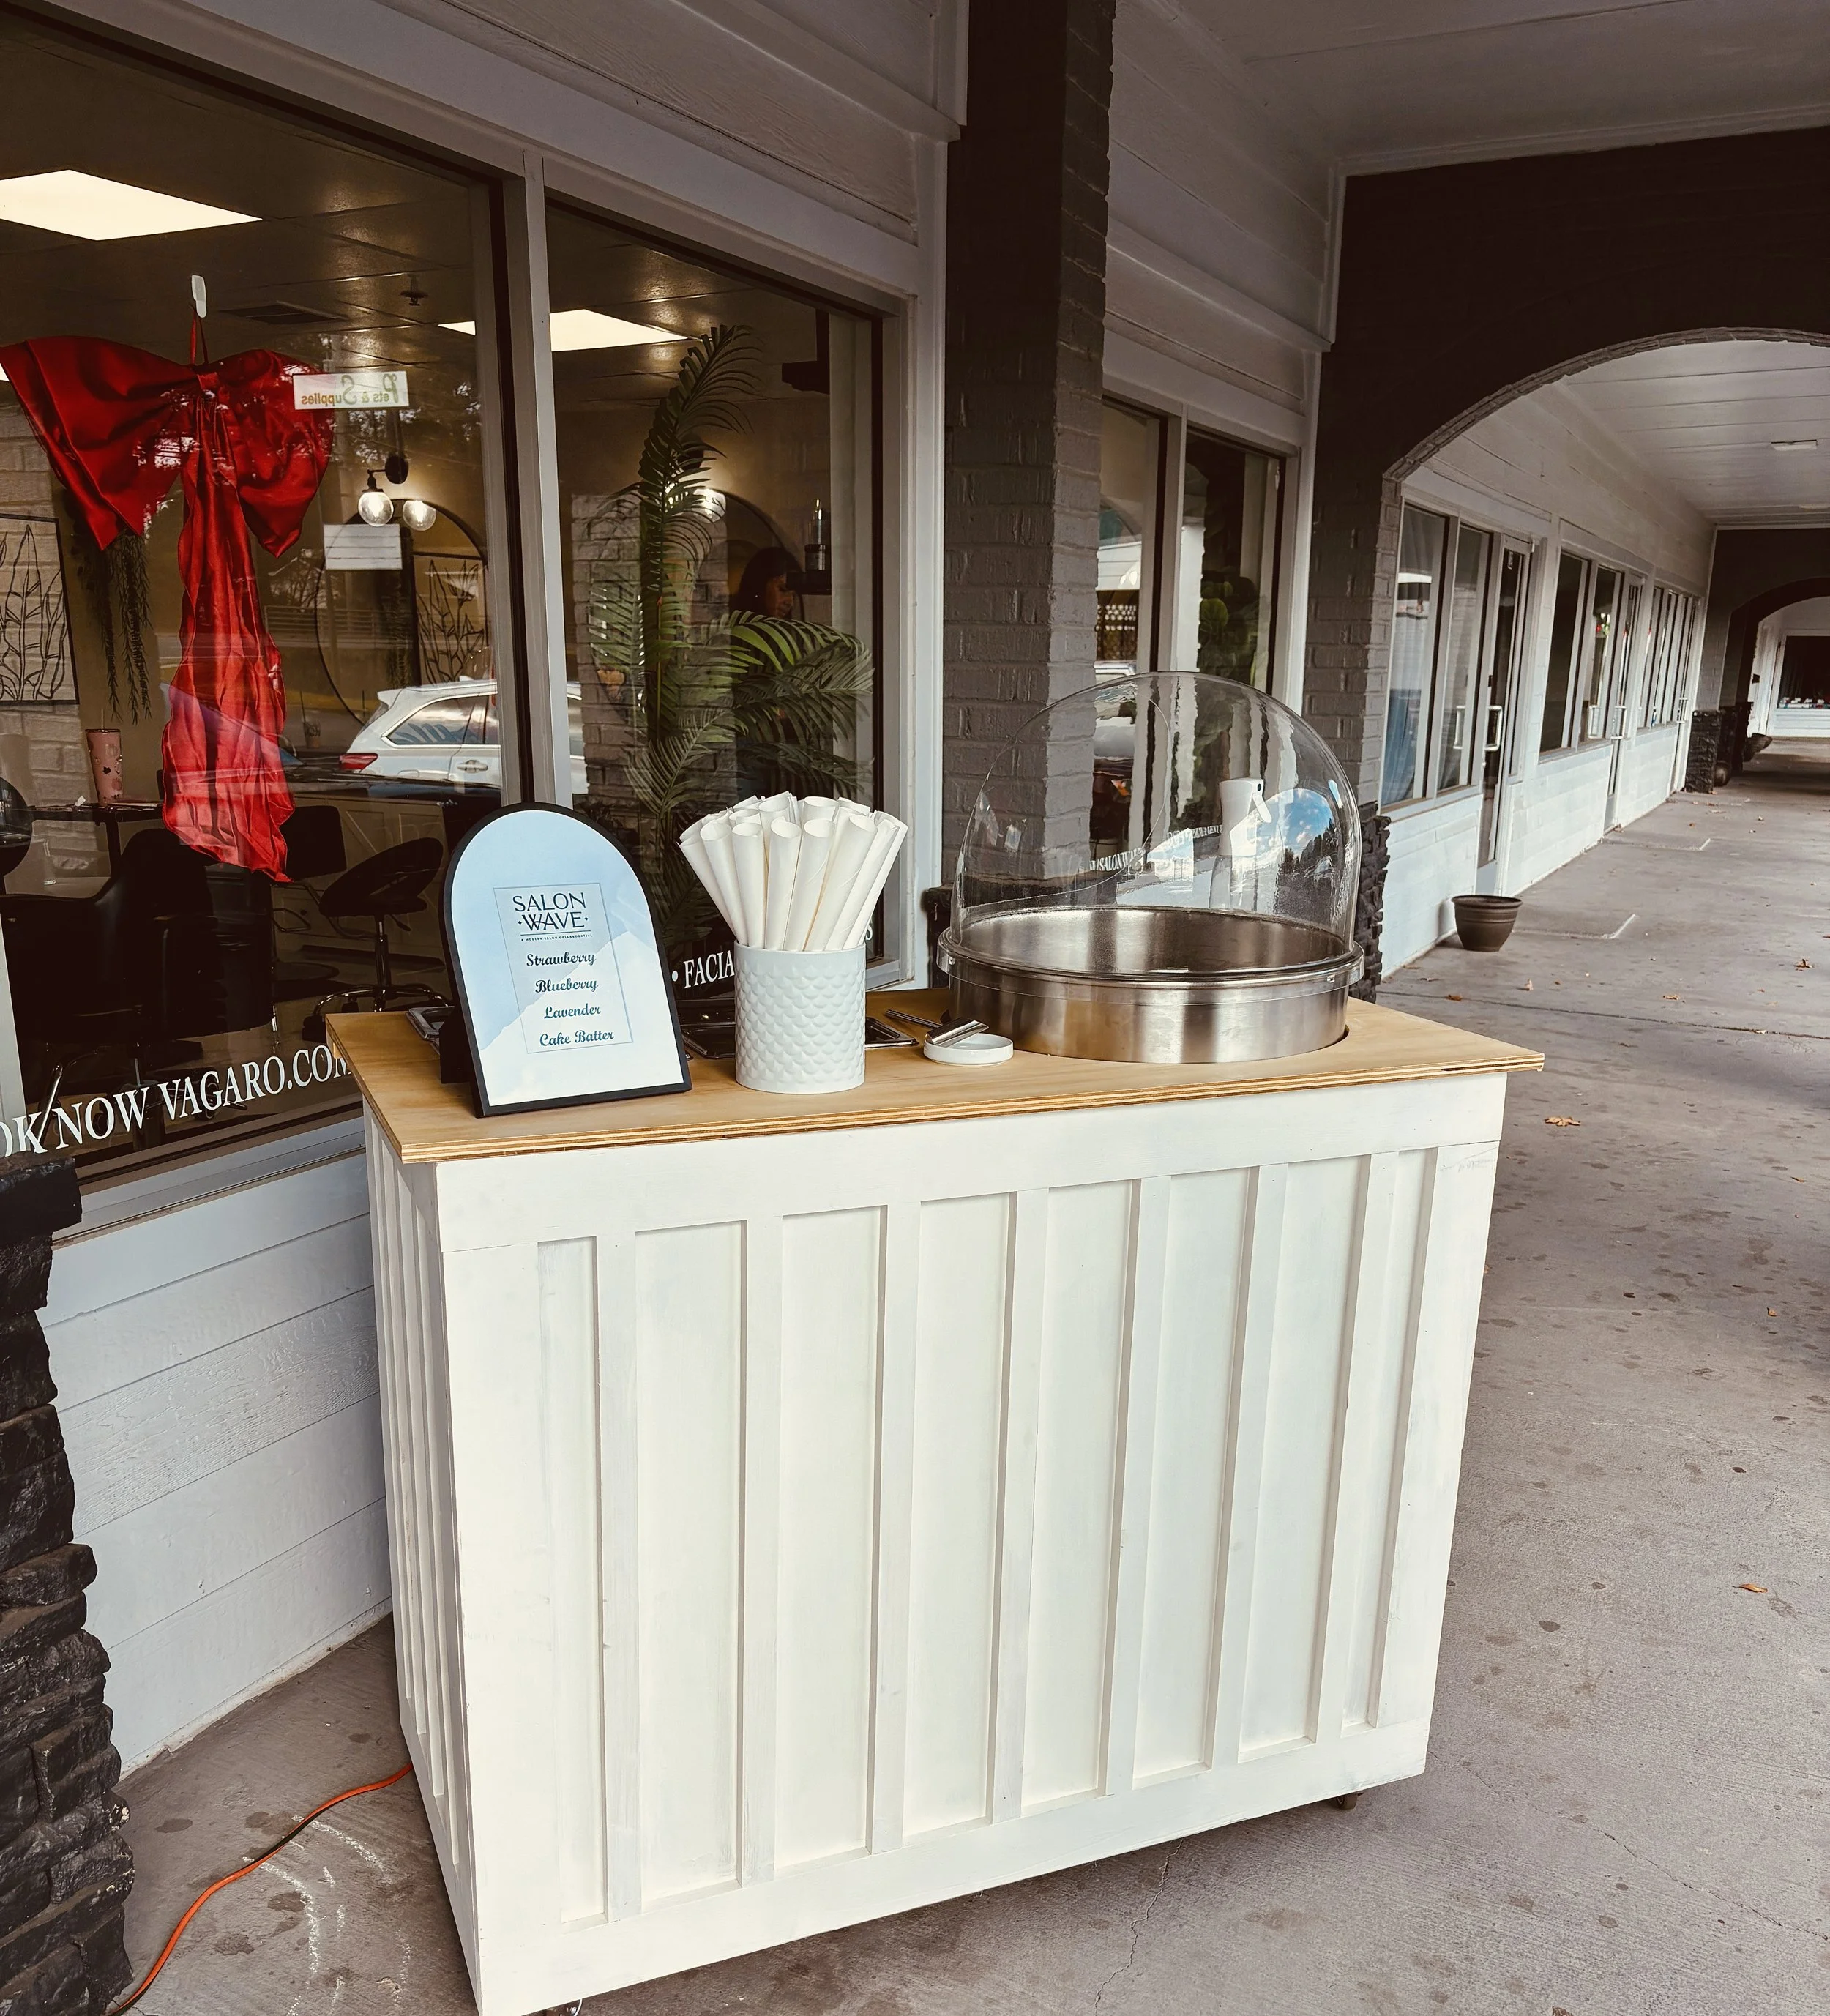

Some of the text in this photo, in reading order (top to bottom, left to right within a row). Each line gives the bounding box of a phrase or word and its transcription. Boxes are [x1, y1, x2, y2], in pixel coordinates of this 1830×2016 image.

[512, 892, 586, 912] SALON
[521, 911, 585, 931] WAVE
[526, 952, 597, 967] Strawberry
[683, 949, 735, 989] FACIA
[535, 978, 599, 993] Blueberry
[544, 1003, 602, 1019] Lavender
[539, 1030, 615, 1047] Cake Batter
[51, 1086, 150, 1150] NOW
